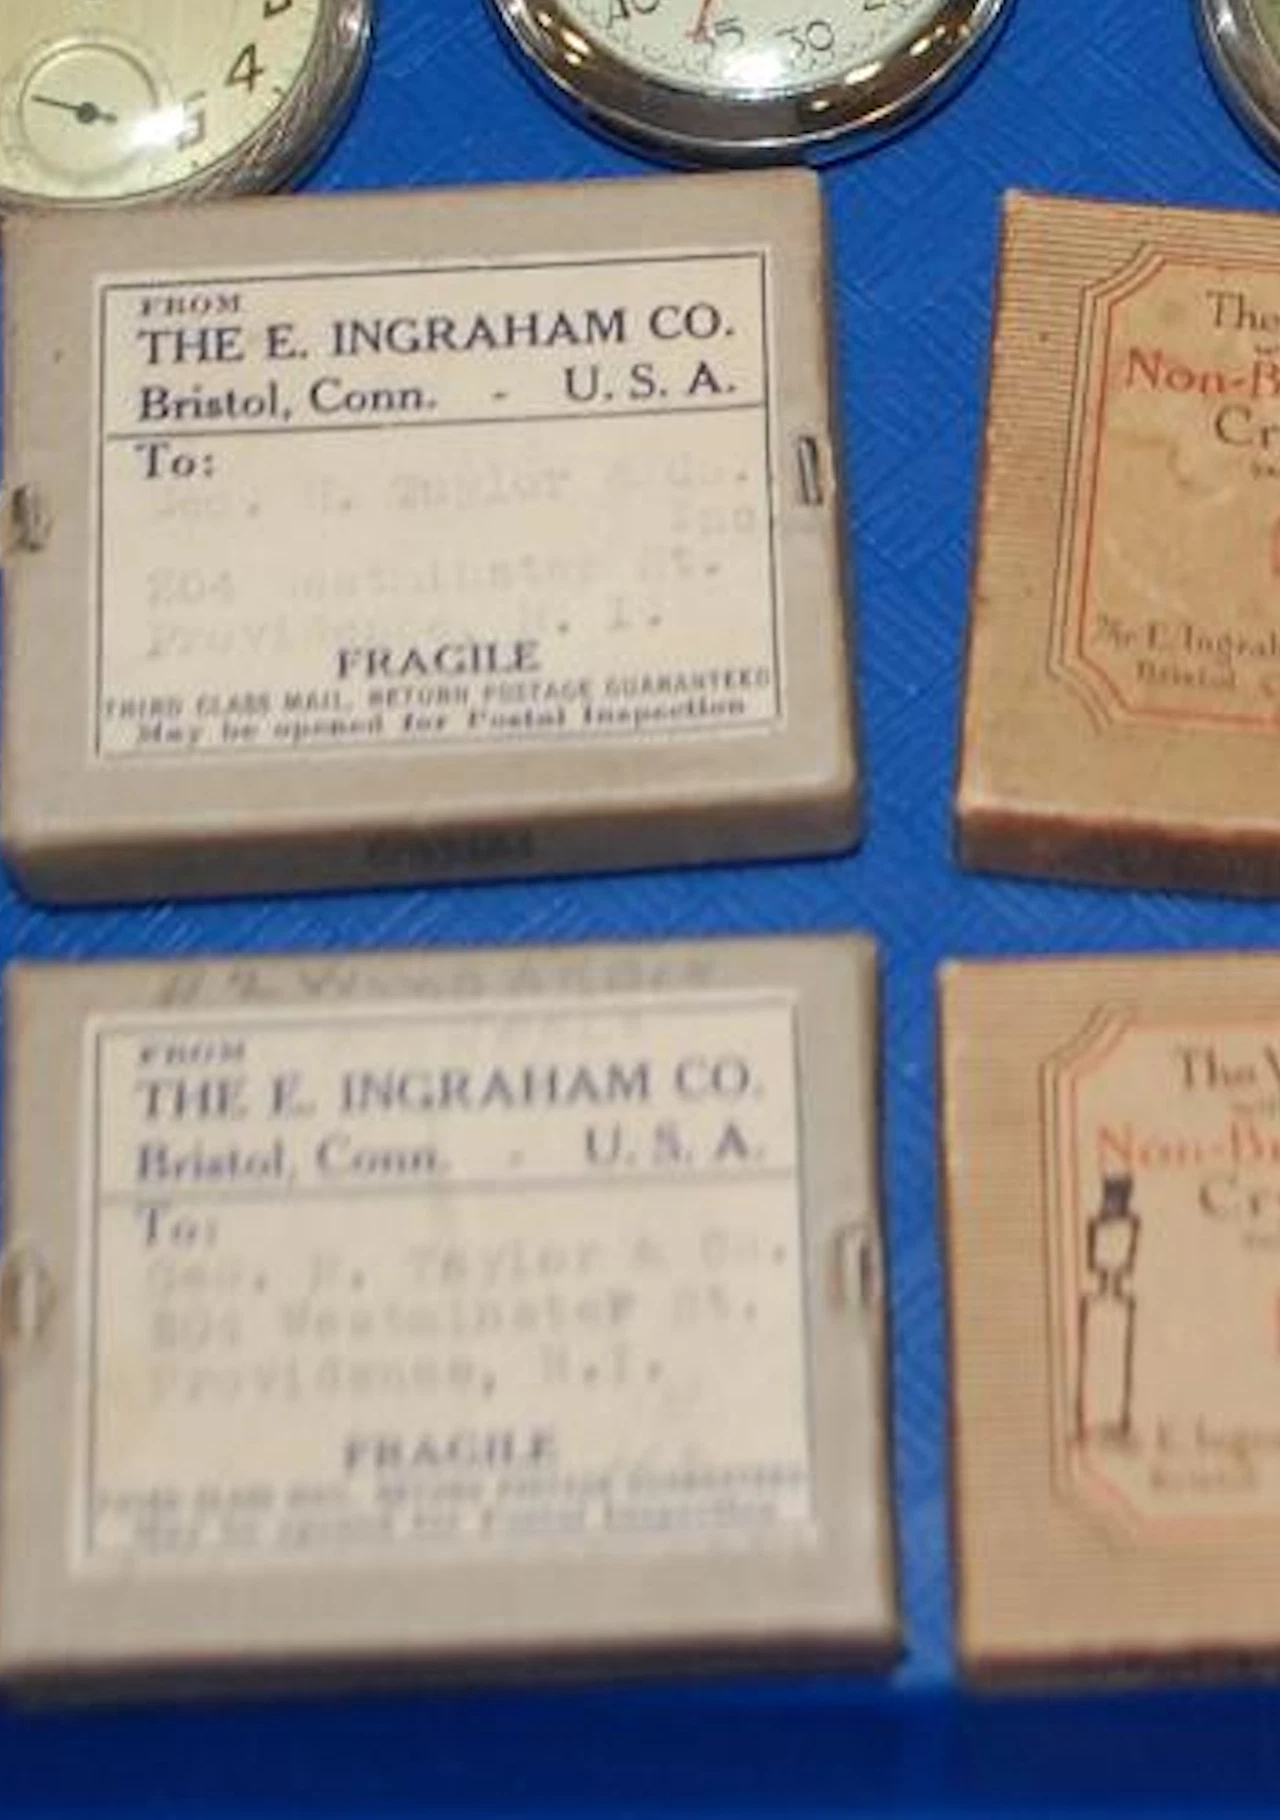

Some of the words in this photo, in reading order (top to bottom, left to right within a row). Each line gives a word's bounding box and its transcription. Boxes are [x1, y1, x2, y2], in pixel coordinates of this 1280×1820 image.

[776, 20, 837, 58] 30
[225, 43, 264, 93] 4
[139, 293, 241, 317] FROM
[136, 325, 245, 365] THE
[266, 323, 308, 361] E.
[332, 306, 627, 358] INGRAHAM
[649, 301, 736, 340] CO.
[138, 379, 292, 423] Bristol,
[310, 376, 437, 415] Conn.
[134, 441, 214, 479] To:
[335, 639, 541, 680] FRAGILE
[196, 690, 269, 717] CLASS
[369, 678, 468, 706] RETURN
[484, 678, 588, 704] POSTAGE
[604, 666, 770, 697] GUARANTEED
[469, 704, 565, 728] Postal
[583, 696, 745, 730] Inspection
[133, 1076, 249, 1119] THE
[342, 1061, 650, 1113] INGRAHAM
[675, 1056, 766, 1103] CO.
[1178, 1045, 1257, 1092] The
[315, 1131, 451, 1173] Conn.
[134, 1199, 217, 1246] To:
[342, 1424, 556, 1473] FRAGILE
